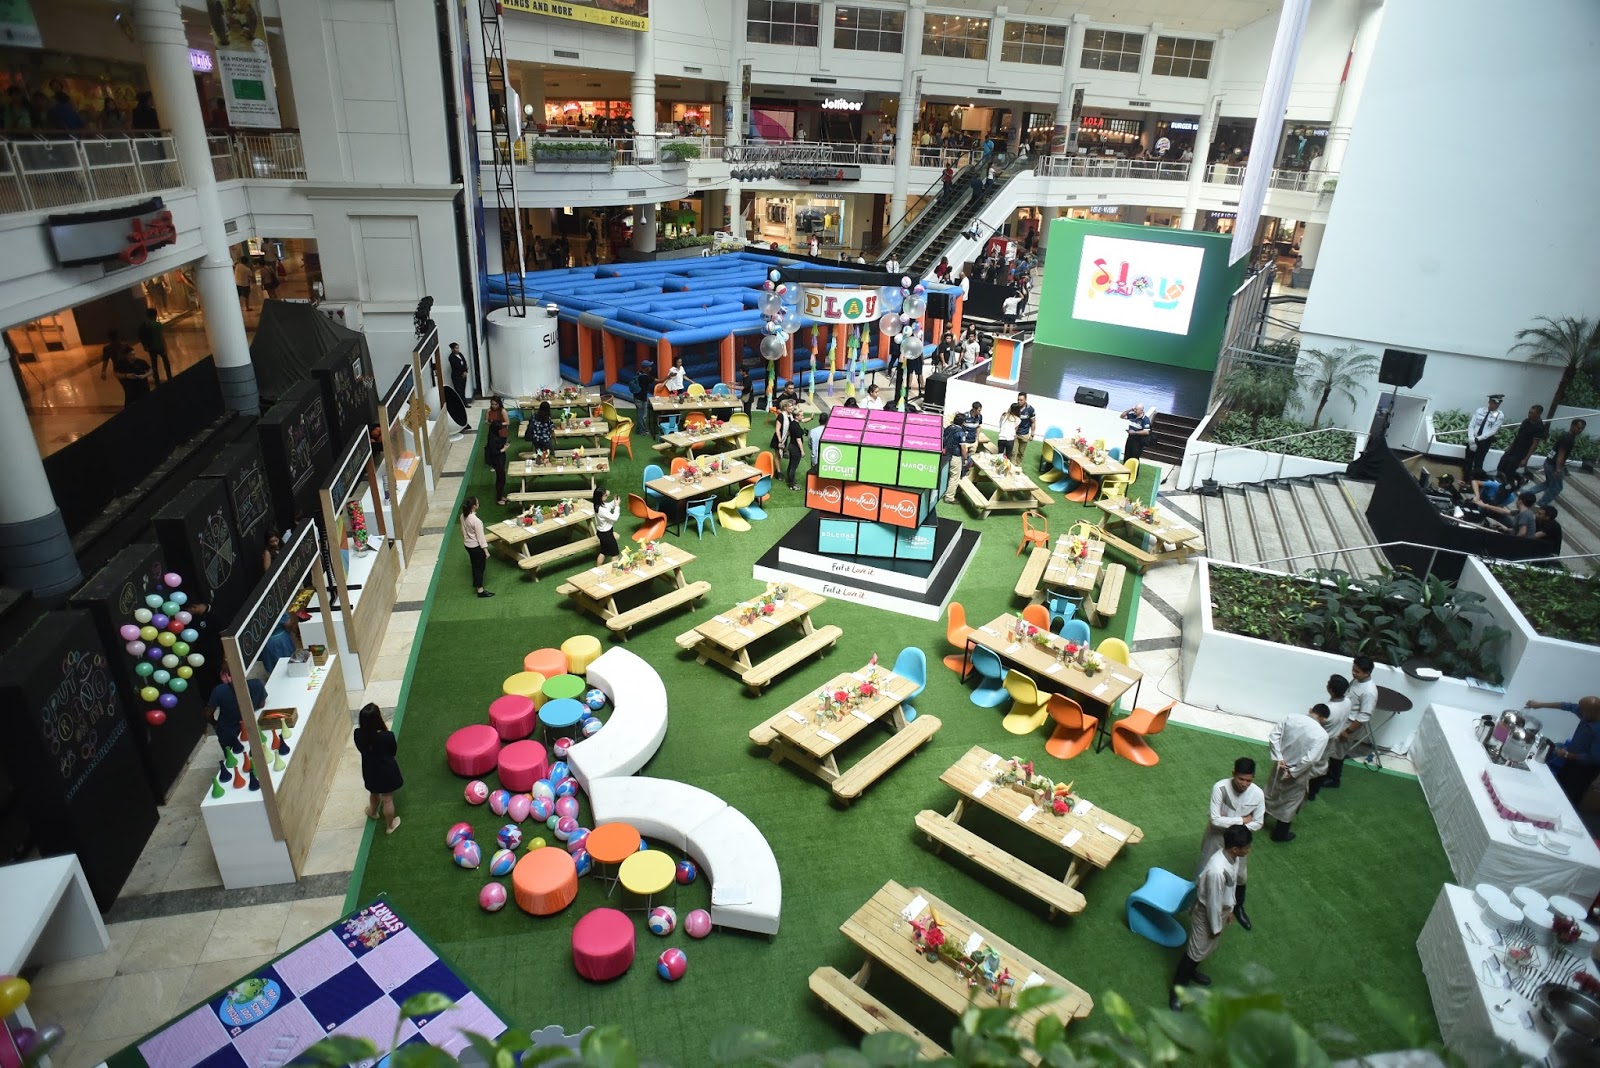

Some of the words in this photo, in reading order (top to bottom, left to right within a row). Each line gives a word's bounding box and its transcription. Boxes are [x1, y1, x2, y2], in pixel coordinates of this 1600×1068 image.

[532, 1, 549, 12] AND
[551, 4, 573, 16] MORE
[821, 98, 862, 110] Jollibee
[1082, 116, 1104, 126] LOLA
[1170, 122, 1192, 130] BURGER
[832, 562, 844, 572] Feel
[852, 566, 866, 574] Love
[822, 585, 836, 593] Feel
[843, 588, 857, 597] Love
[370, 902, 404, 932] START
[267, 988, 278, 1000] YOU
[250, 1002, 264, 1016] BAGS
[260, 998, 270, 1008] FOR
[240, 1008, 253, 1020] LOOT
[326, 1022, 336, 1030] 8
[418, 1018, 427, 1027] 3
